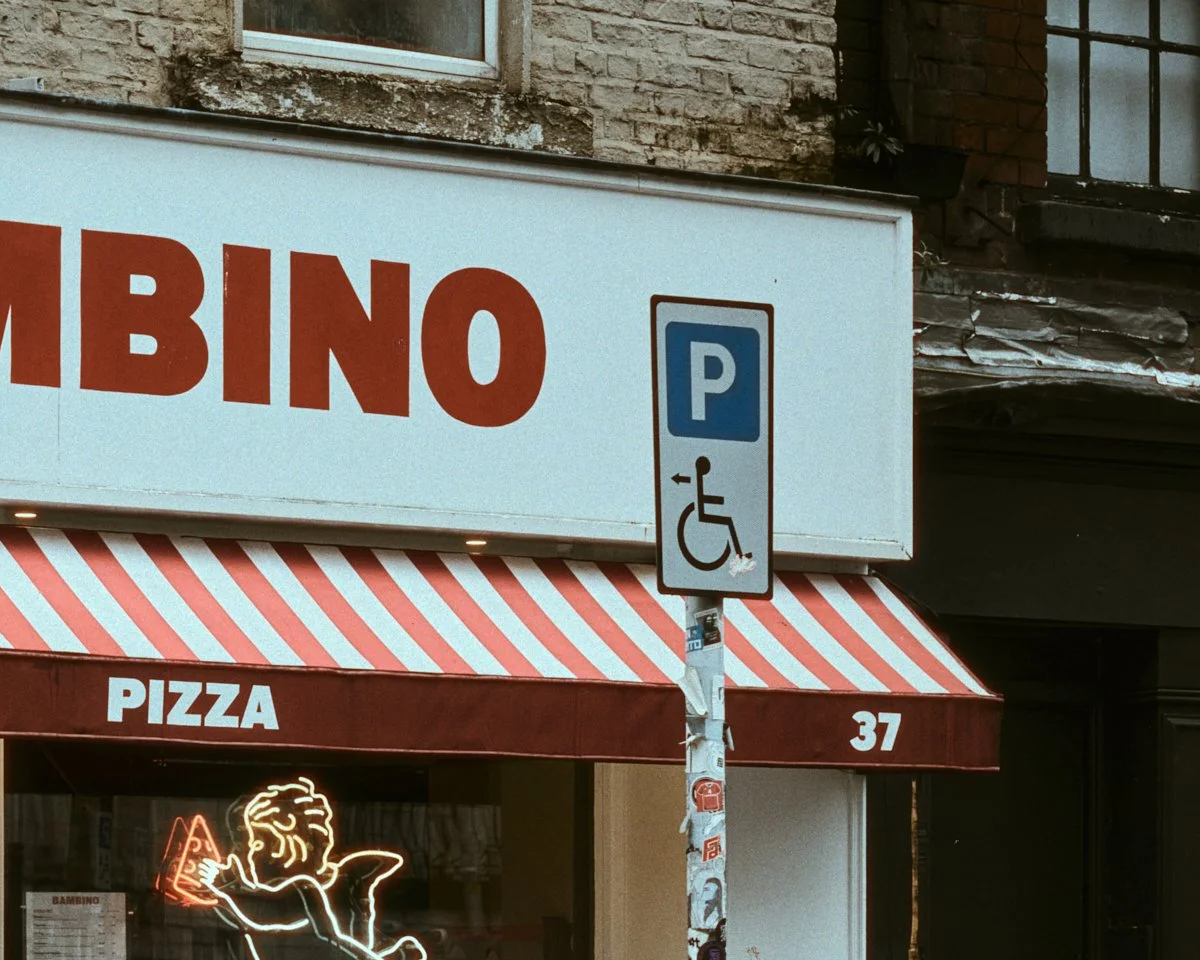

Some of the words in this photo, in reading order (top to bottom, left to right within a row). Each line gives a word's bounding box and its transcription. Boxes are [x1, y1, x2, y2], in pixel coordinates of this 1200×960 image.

[690, 341, 736, 421] P
[105, 676, 280, 730] PIZZA
[849, 711, 902, 752] 37
[52, 896, 100, 905] BAMBINO
